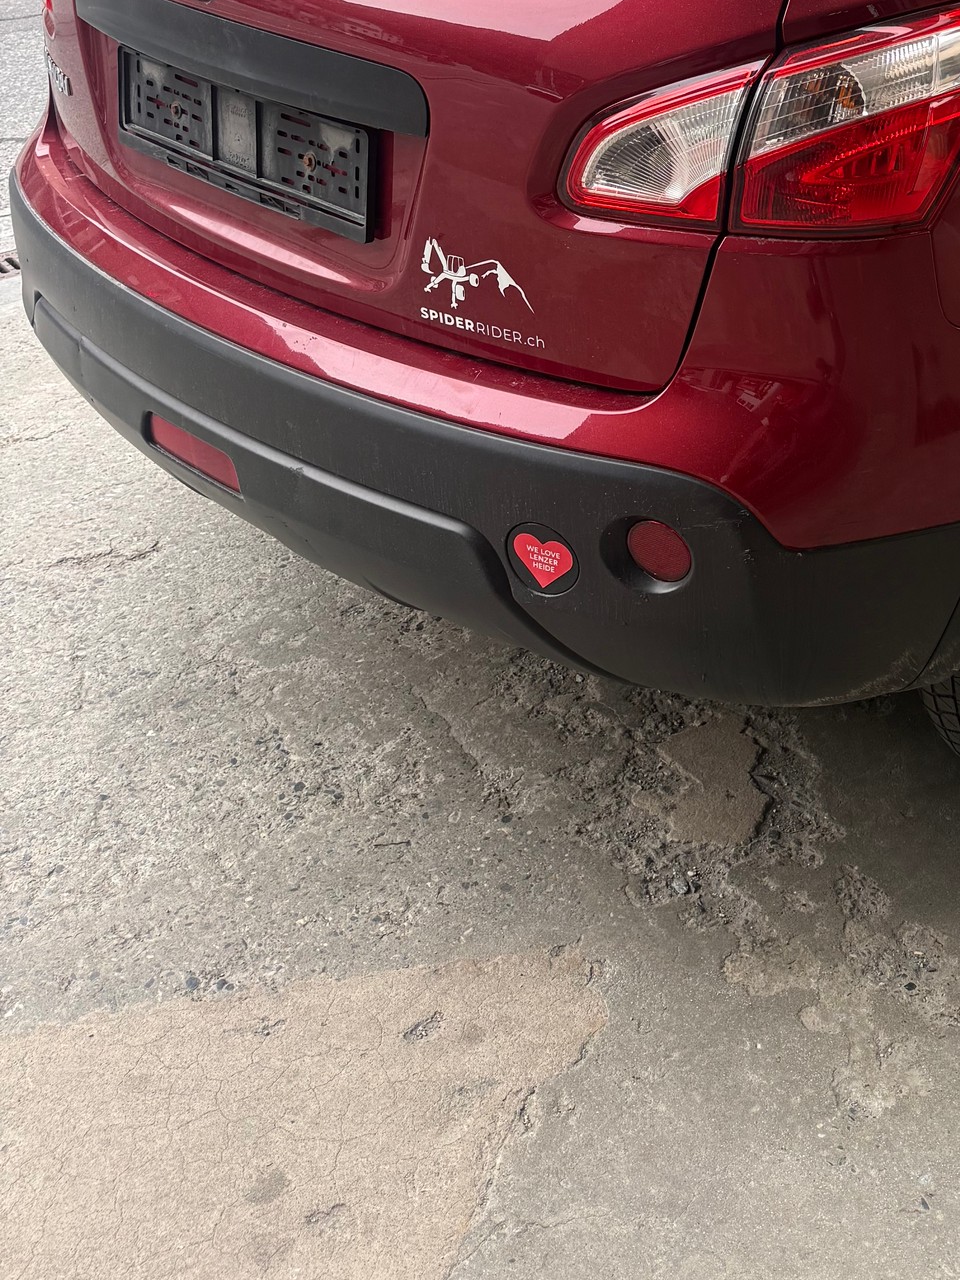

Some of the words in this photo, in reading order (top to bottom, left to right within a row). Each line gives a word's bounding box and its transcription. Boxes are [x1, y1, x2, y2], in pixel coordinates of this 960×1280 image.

[420, 306, 546, 349] SPIDERRIDER.ch
[526, 544, 539, 554] WE
[540, 546, 561, 560] LOVE
[529, 552, 559, 567] LENZER
[532, 561, 556, 574] HEIDE
